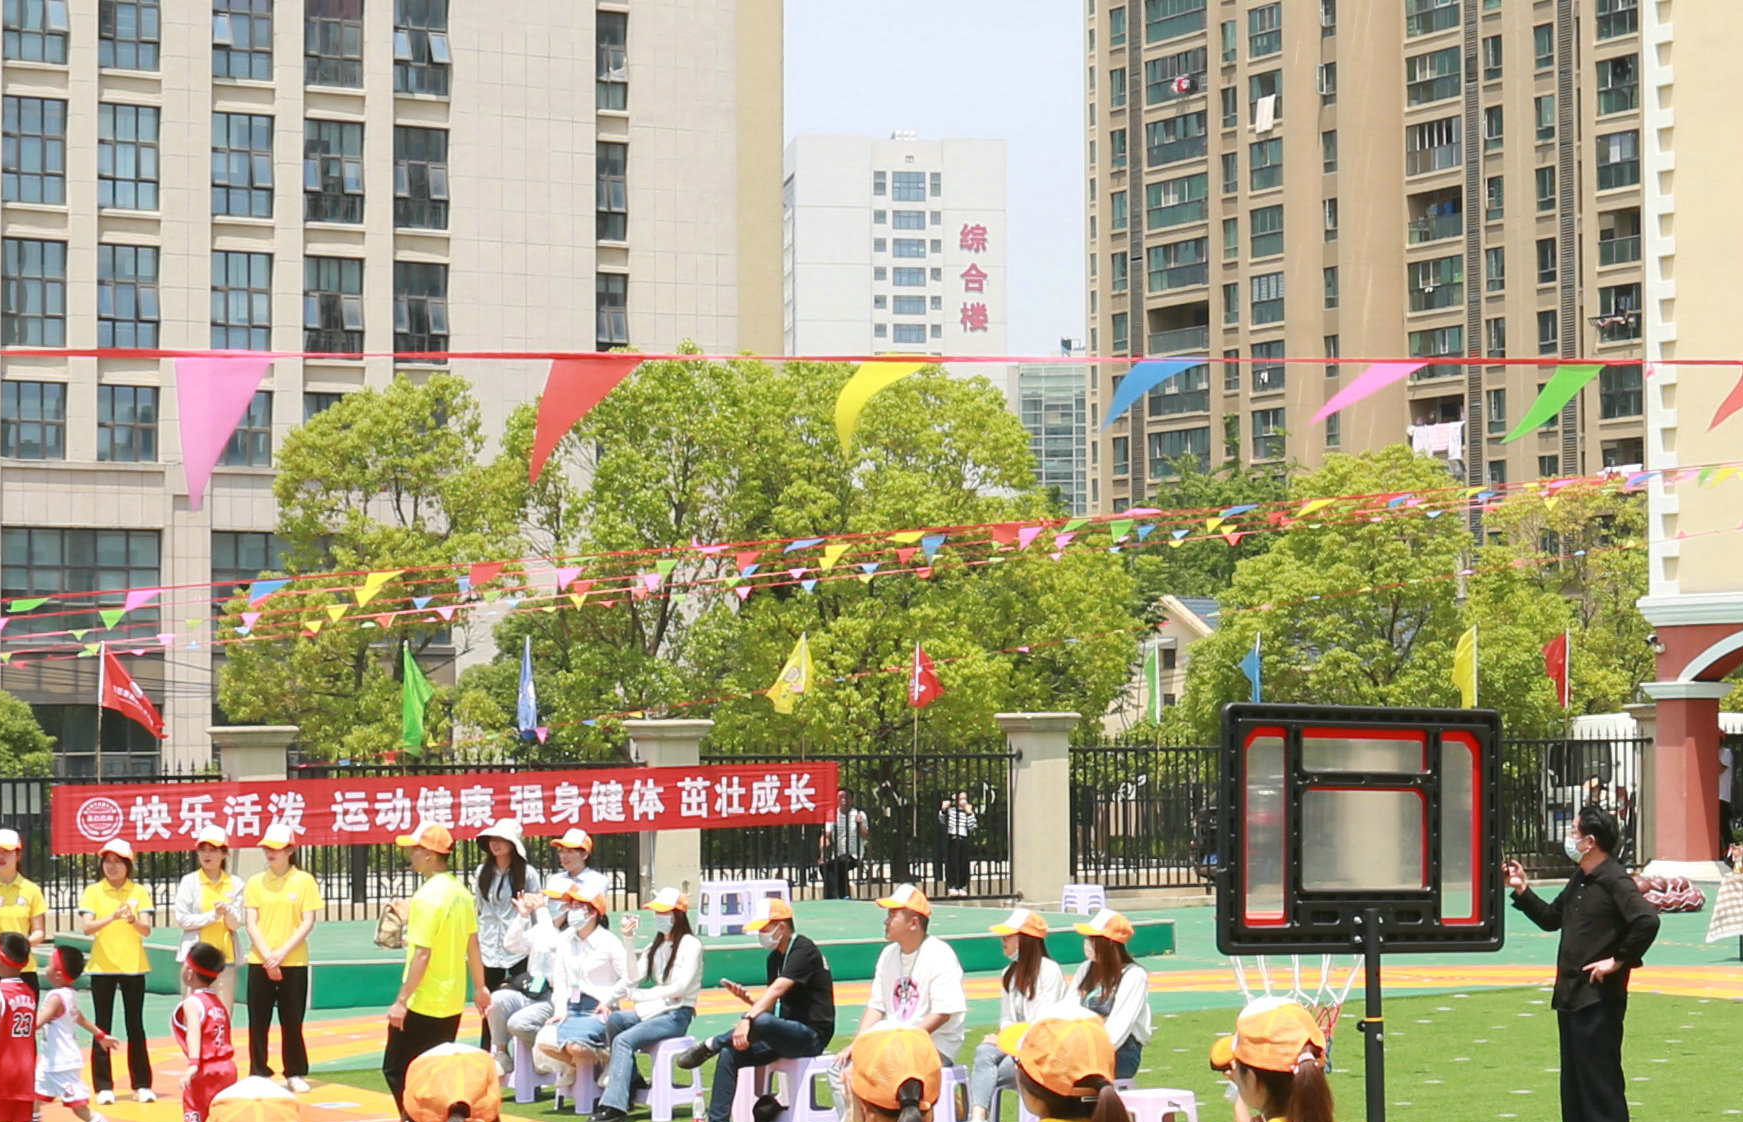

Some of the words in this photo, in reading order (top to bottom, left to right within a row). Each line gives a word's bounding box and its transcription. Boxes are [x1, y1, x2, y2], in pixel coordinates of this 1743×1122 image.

[960, 224, 988, 332] 综合楼
[129, 791, 306, 840] 快乐活泼
[331, 785, 496, 833] 运动健康
[508, 778, 665, 826] 强身健体
[677, 773, 816, 818] 茁壮成长
[12, 1012, 34, 1037] 23
